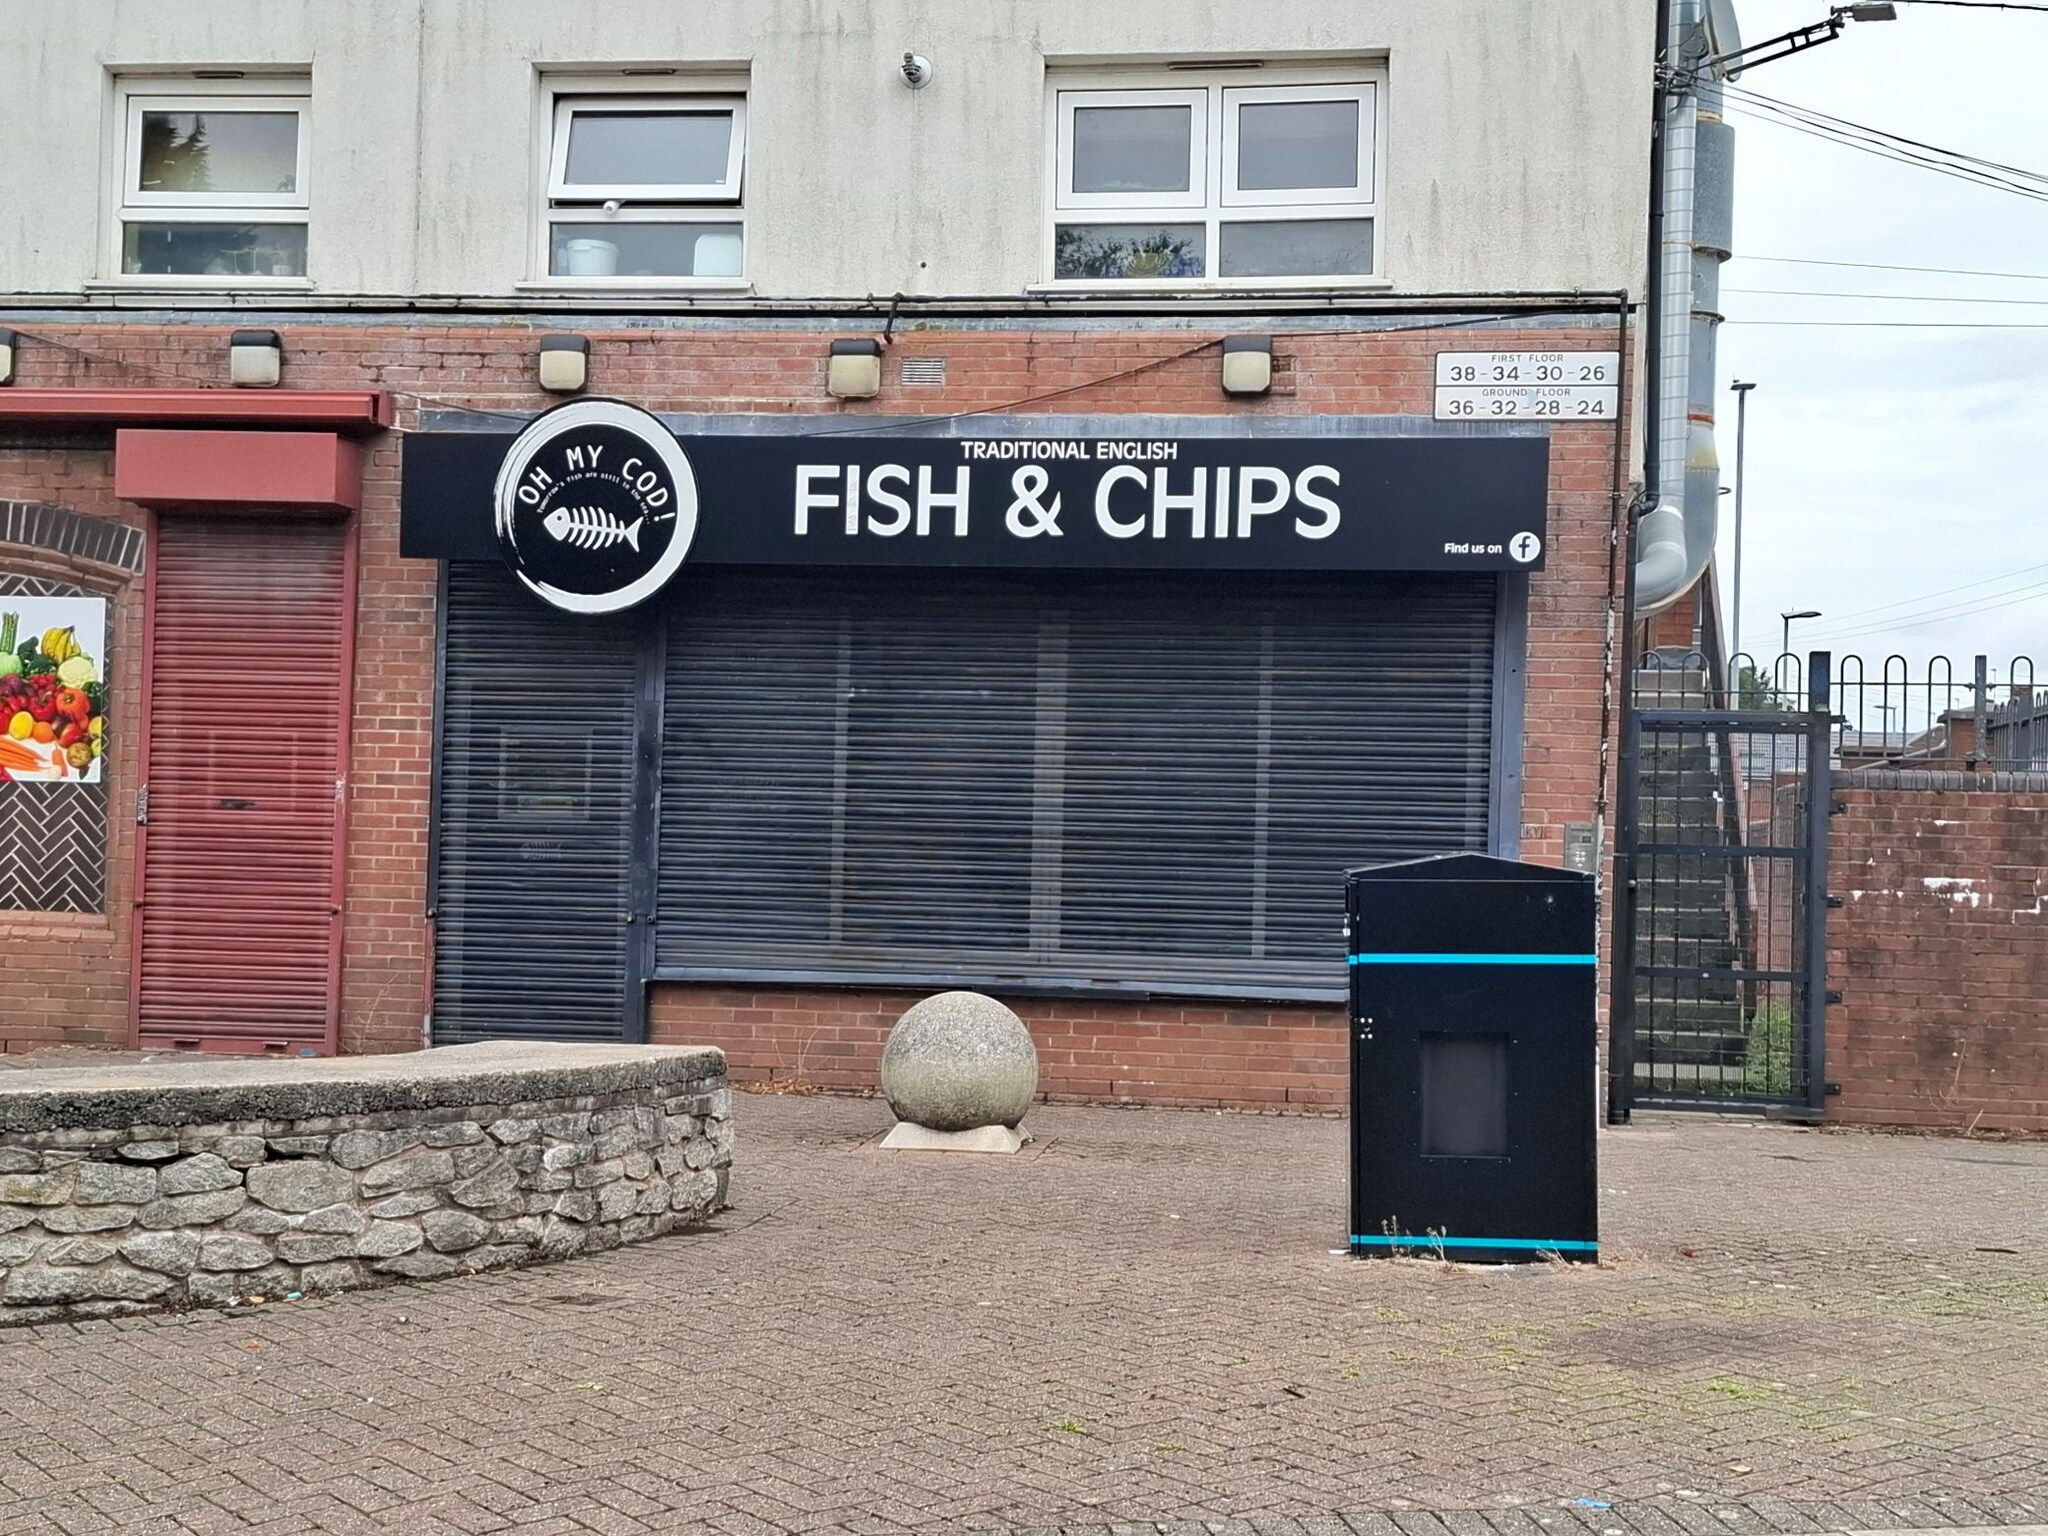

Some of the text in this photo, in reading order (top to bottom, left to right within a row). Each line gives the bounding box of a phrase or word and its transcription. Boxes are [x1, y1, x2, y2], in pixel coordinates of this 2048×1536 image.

[1491, 354, 1564, 363] FIRST FLOOR
[1450, 366, 1476, 382] 38
[1492, 366, 1520, 382] 34
[1536, 365, 1563, 381] 30
[1579, 365, 1605, 381] 26
[1481, 388, 1571, 397] GROUND FLOOR
[1449, 400, 1474, 416] 36
[1491, 400, 1517, 416] 32
[1535, 400, 1560, 416] 28
[1577, 400, 1604, 416] 24
[961, 441, 1178, 460] TRADITIONAL ENGLISH
[518, 445, 676, 522] OH MY COD!
[794, 463, 970, 537] FISH
[1005, 464, 1064, 538] &
[1095, 464, 1341, 539] CHIPS
[1444, 542, 1469, 554] Find
[1471, 544, 1485, 554] us
[1487, 544, 1502, 554] on
